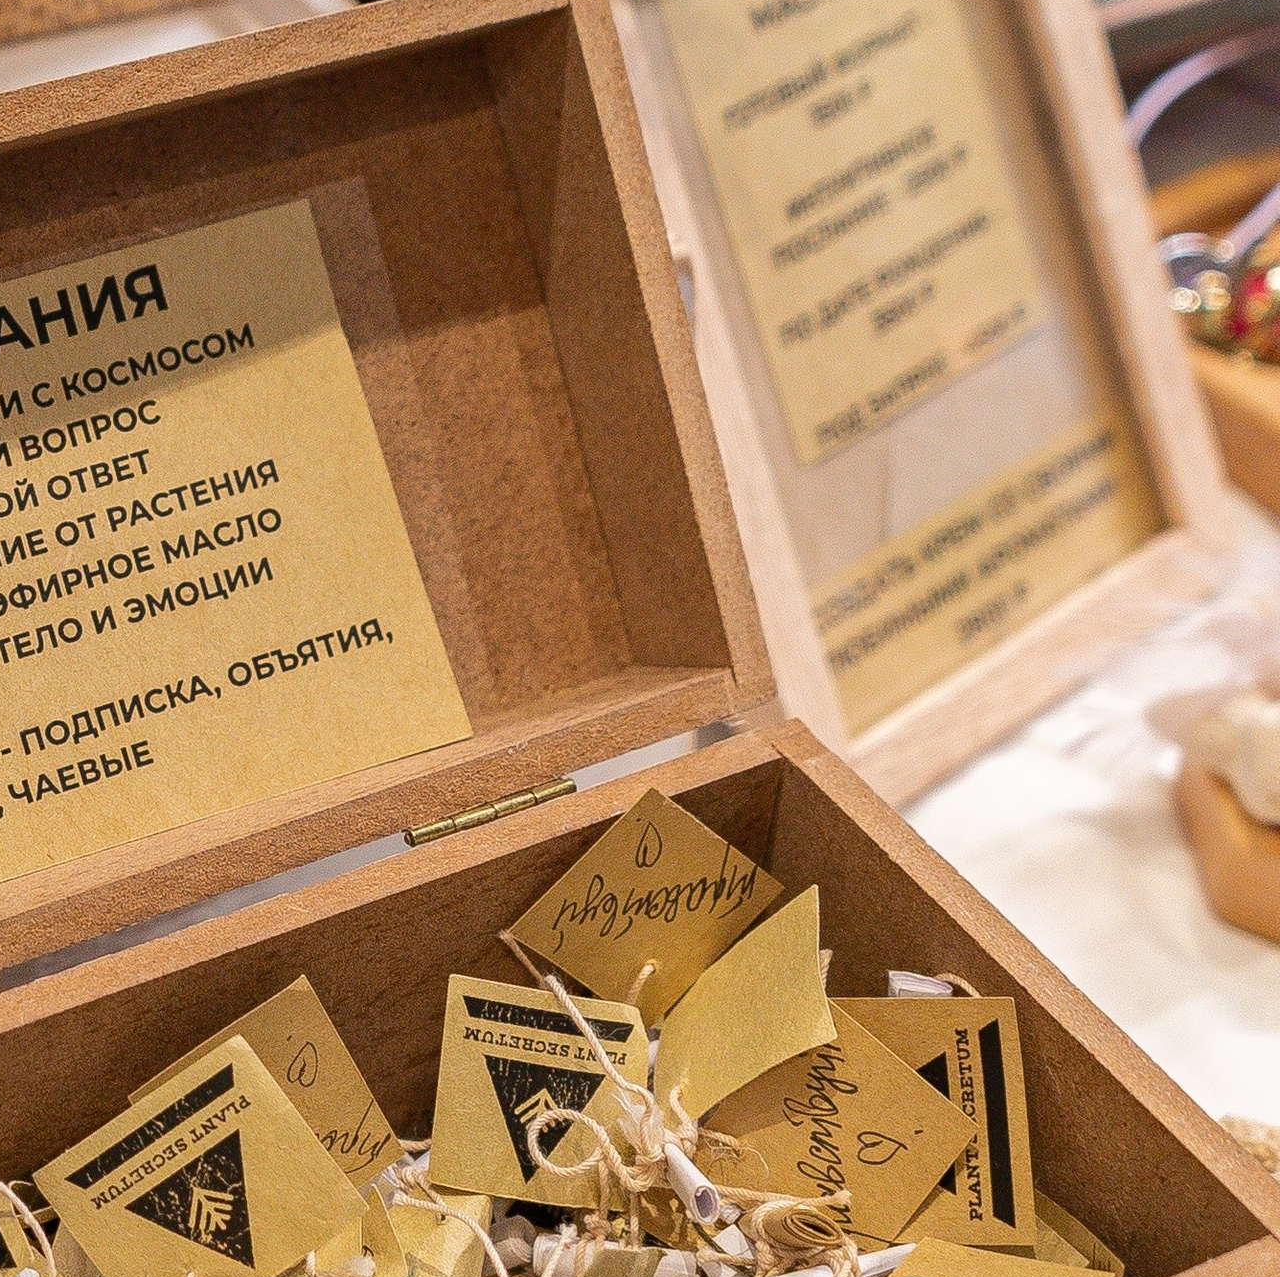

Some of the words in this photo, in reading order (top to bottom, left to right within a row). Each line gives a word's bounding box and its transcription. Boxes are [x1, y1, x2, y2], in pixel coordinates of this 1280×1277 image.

[31, 382, 55, 408] С
[60, 323, 255, 401] КОСМОСОМ
[19, 400, 161, 461] ВОПРОС
[47, 449, 149, 501] ОТВЕТ
[55, 513, 96, 547] ОТ
[106, 459, 279, 532] РАСТЕНИЯ
[161, 508, 282, 564] МАСЛО
[90, 605, 117, 635] И
[123, 557, 273, 624] ЭМОЦИИ
[19, 675, 222, 756] ПОДПИСКА,
[227, 618, 393, 687] ОБЪЯТИЯ,
[7, 740, 154, 804] ЧАЕВЫЕ
[462, 1026, 570, 1058] SECRETUM
[191, 1094, 252, 1144] PLANT
[92, 1139, 188, 1211] SECRETUM
[970, 1147, 984, 1222] PLANT
